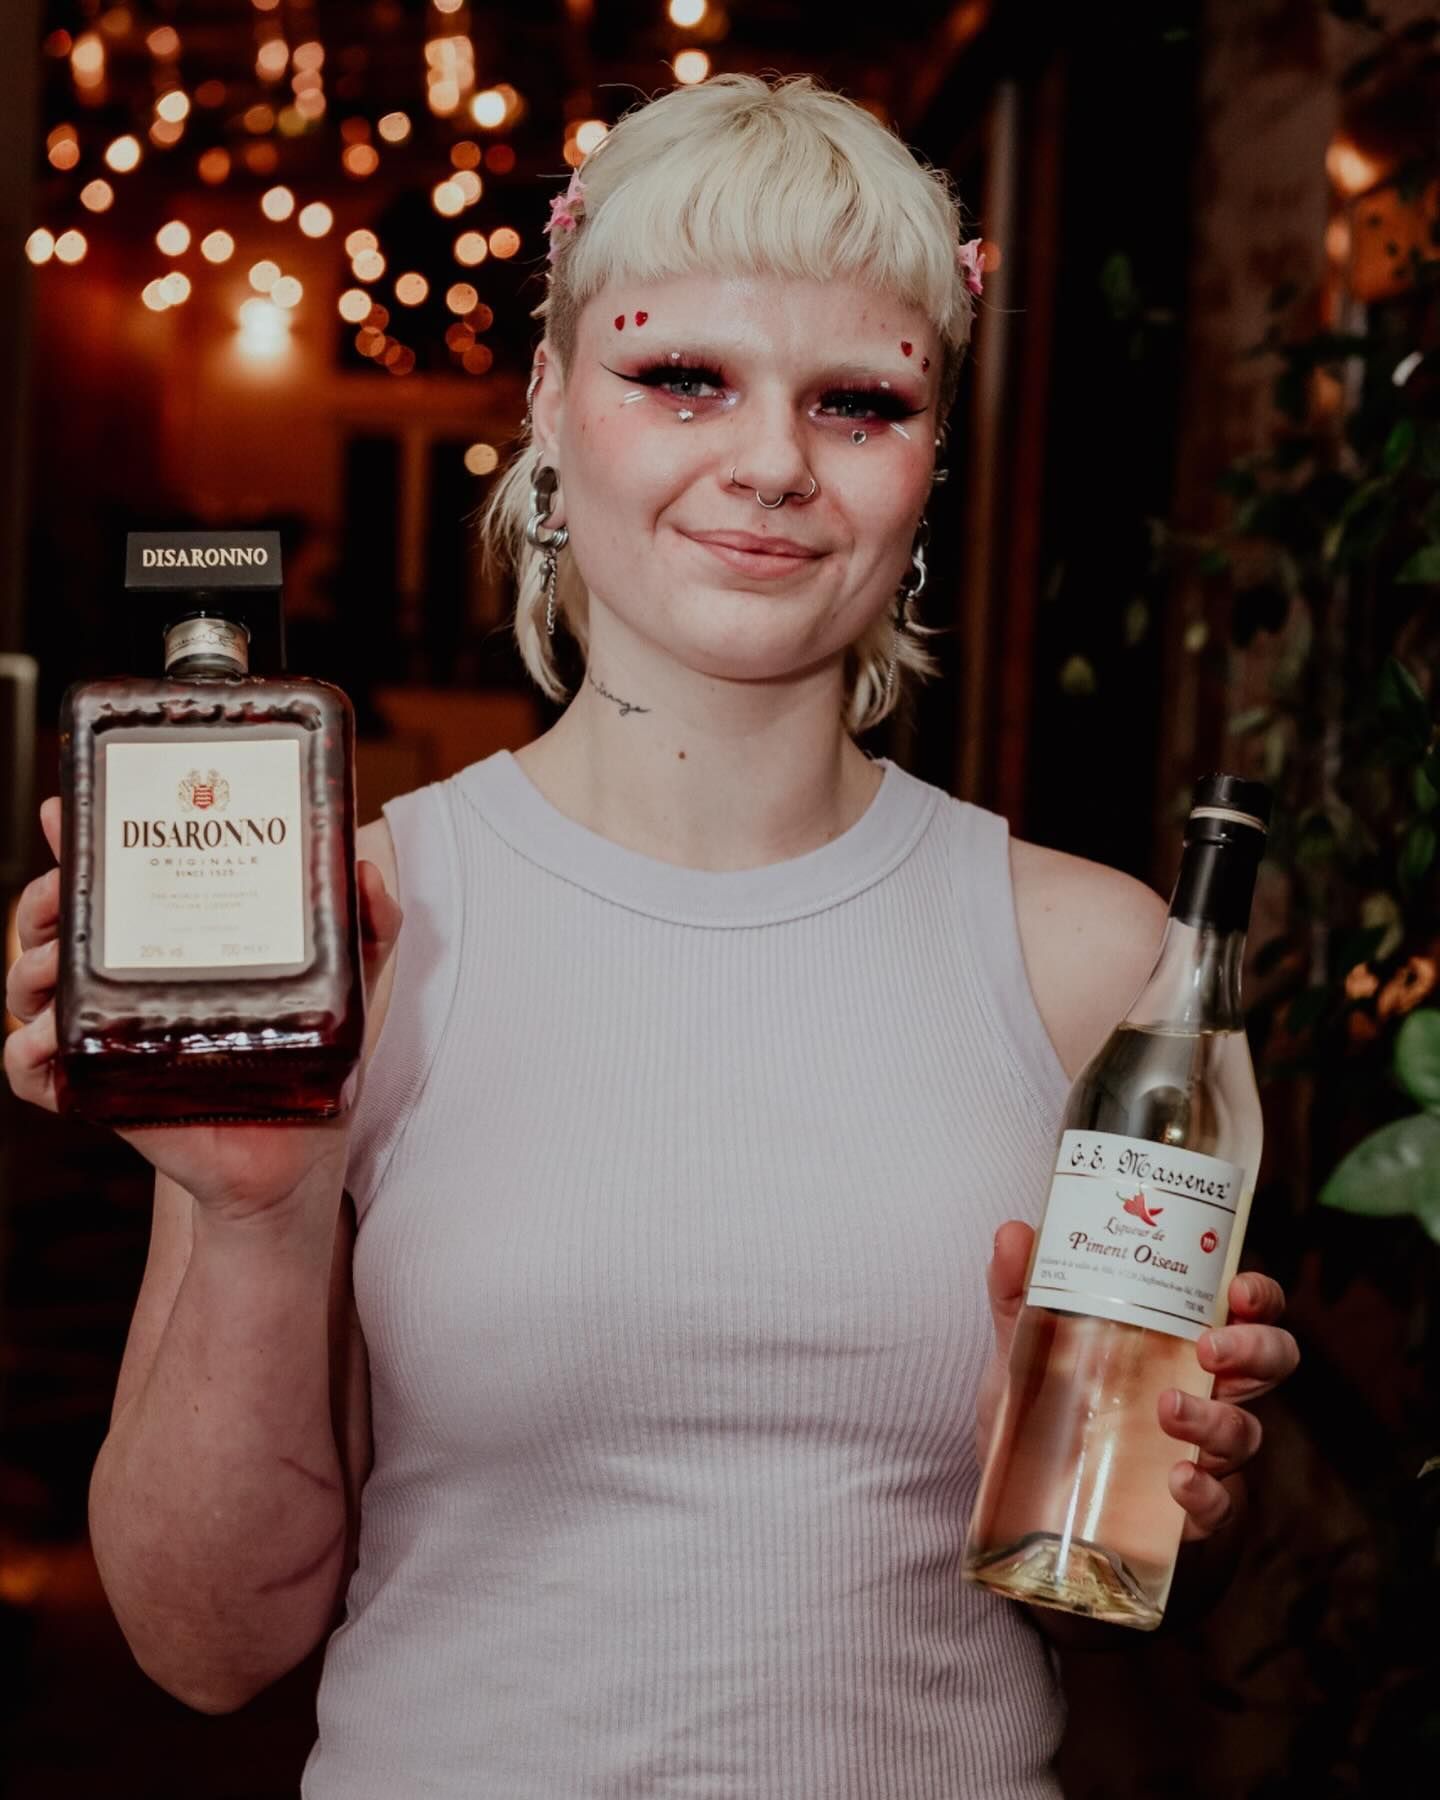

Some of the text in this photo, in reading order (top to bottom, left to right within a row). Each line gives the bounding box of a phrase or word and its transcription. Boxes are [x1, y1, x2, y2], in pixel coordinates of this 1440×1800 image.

[142, 547, 268, 569] DISARONNO
[122, 816, 286, 851] DISARONNO
[149, 856, 259, 867] ORIGINALE
[1152, 1229, 1166, 1242] de
[1069, 1231, 1127, 1259] Piment
[1134, 1244, 1190, 1275] Oiseau
